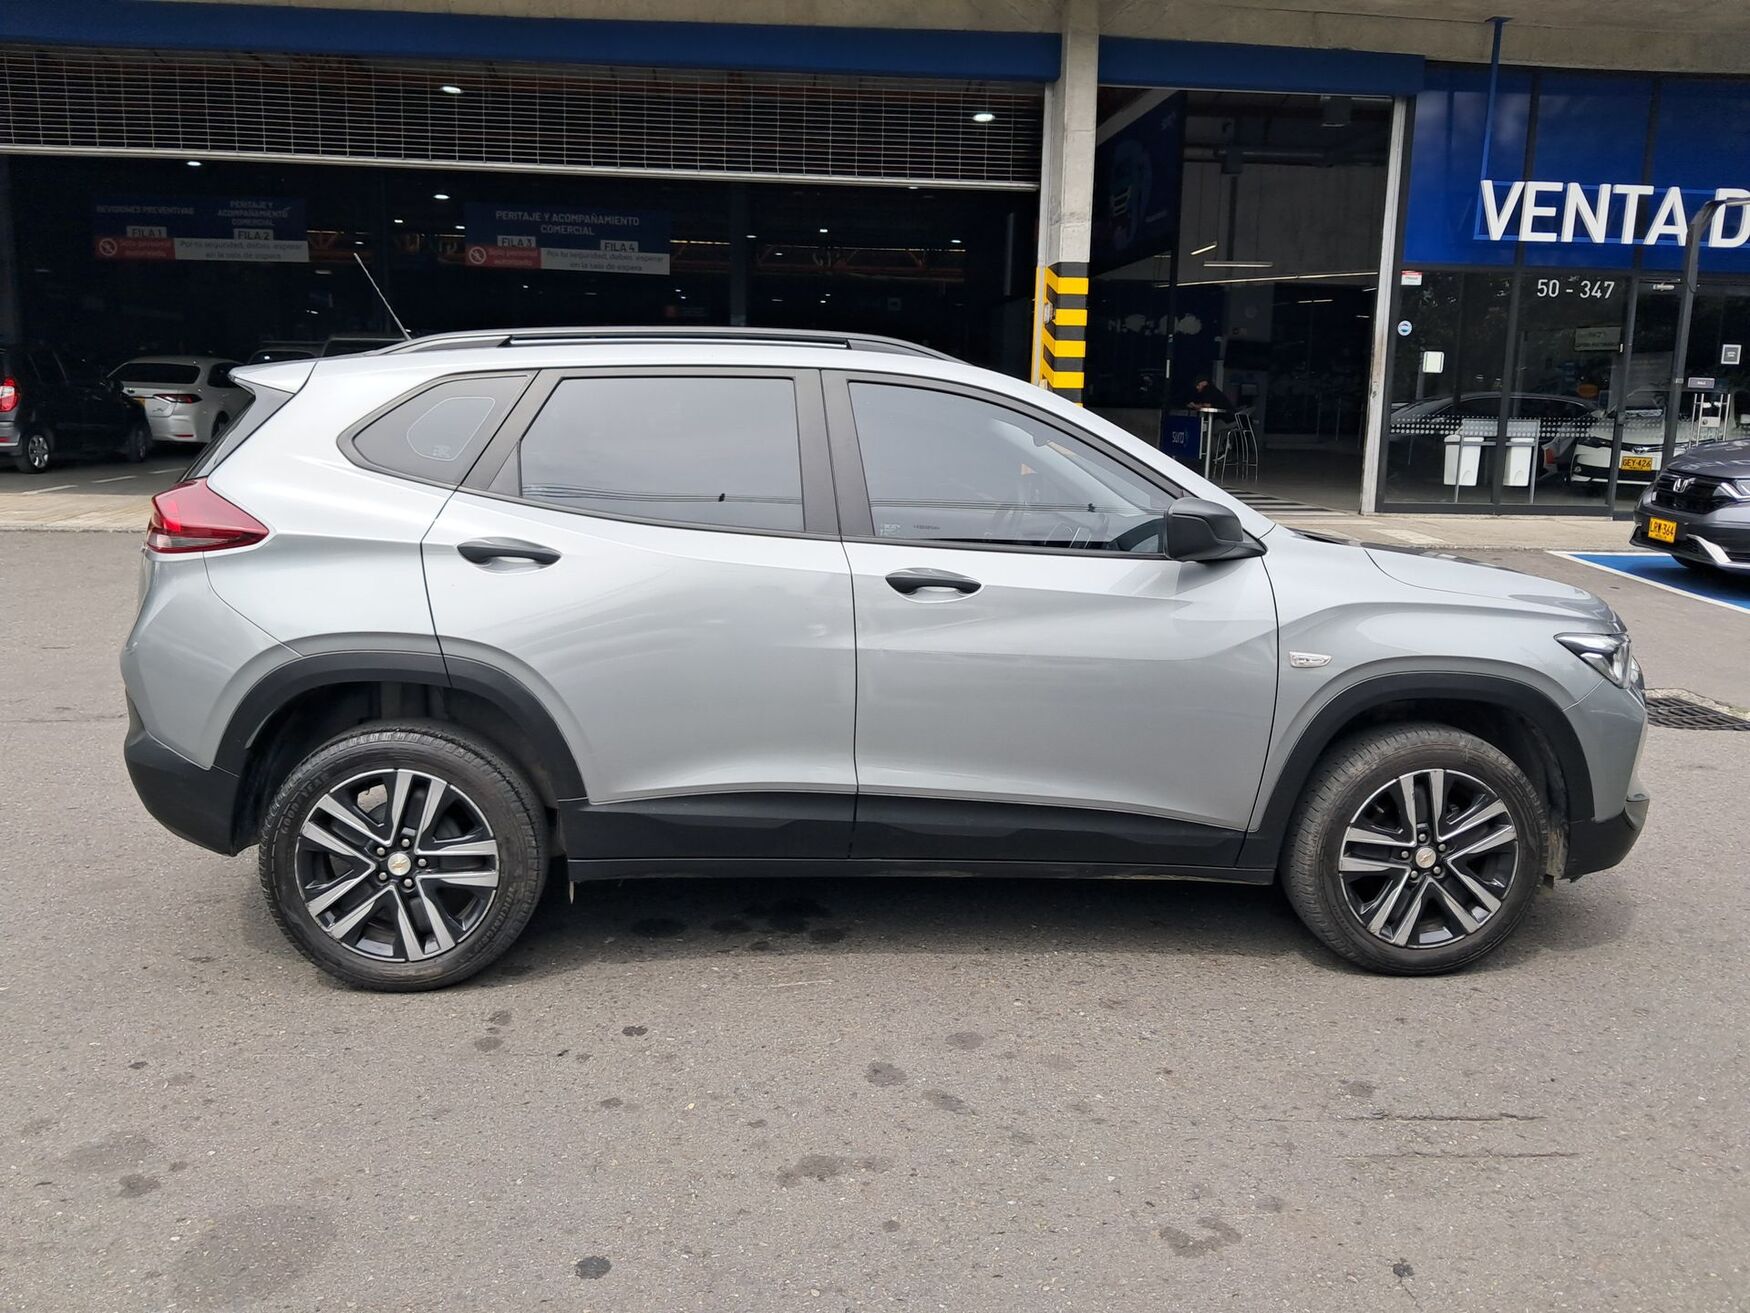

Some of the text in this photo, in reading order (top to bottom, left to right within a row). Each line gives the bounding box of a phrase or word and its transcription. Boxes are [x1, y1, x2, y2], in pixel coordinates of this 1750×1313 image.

[496, 210, 640, 226] PERITAJE Y ACOMPAÑAMIENTO
[1480, 179, 1688, 247] VENTA
[132, 228, 156, 237] FILA
[238, 231, 270, 240] FILA 2
[541, 224, 595, 236] COMERCIAL
[501, 237, 533, 247] FILA 3
[604, 242, 635, 251] FILA 4
[1537, 279, 1560, 298] 50
[1579, 280, 1615, 299] 347
